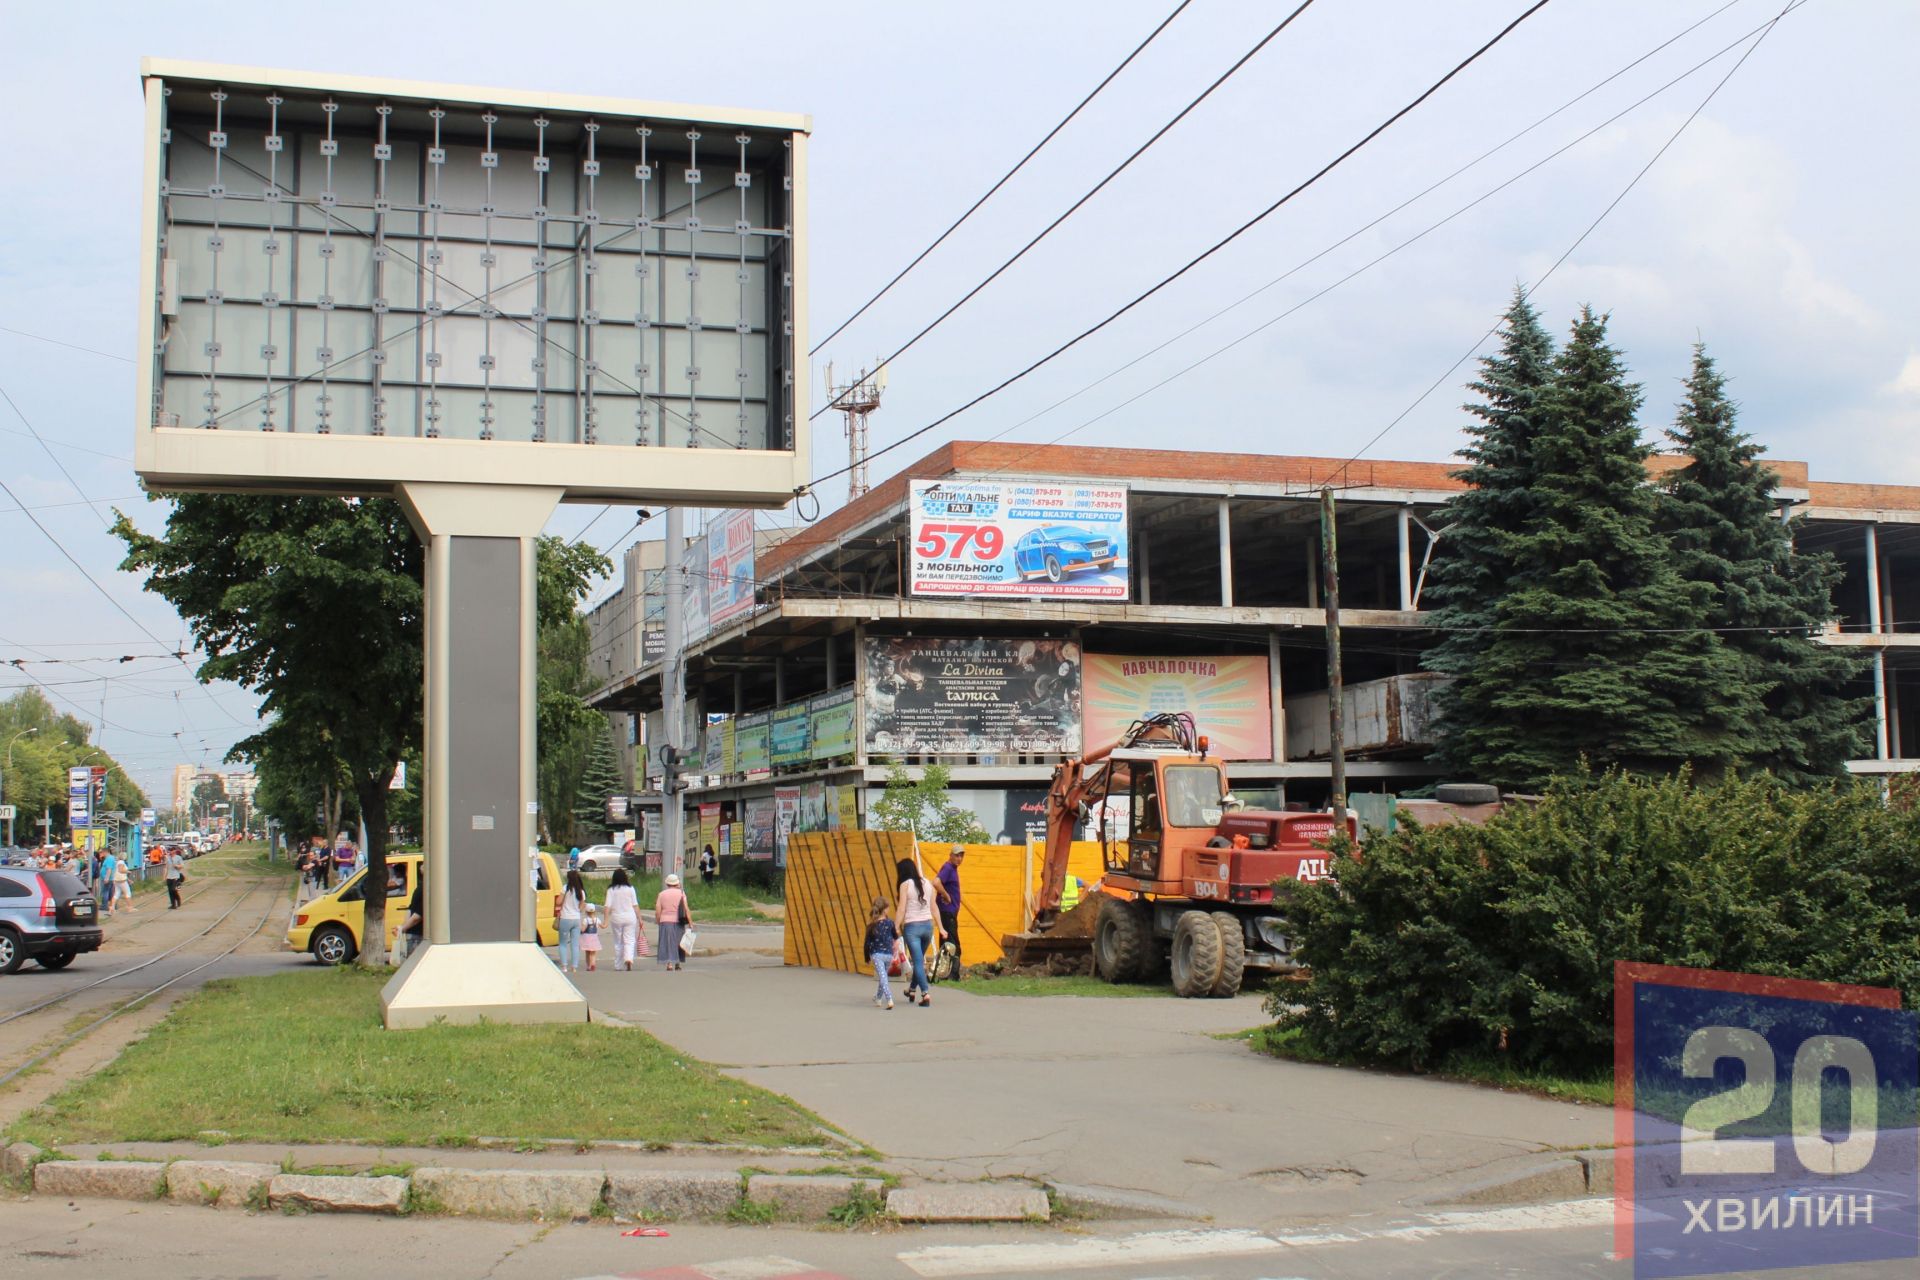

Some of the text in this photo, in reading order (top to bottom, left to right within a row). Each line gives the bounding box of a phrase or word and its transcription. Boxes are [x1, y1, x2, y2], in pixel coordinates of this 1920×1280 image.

[929, 491, 1000, 502] ОПТИМАЛЬНЕ
[951, 504, 969, 512] TAXI
[1076, 512, 1121, 520] ОПЕРАТОР
[916, 523, 1004, 560] 579
[927, 563, 1004, 573] МОБІЛЬНОГО
[911, 649, 997, 657] ТАНЦЕВАЛЬНЫЙ
[941, 663, 1004, 676] La Divina
[1122, 660, 1217, 677] НАВЧАЛОЧКА
[1296, 859, 1333, 881] ATL
[1194, 880, 1219, 897] 1304
